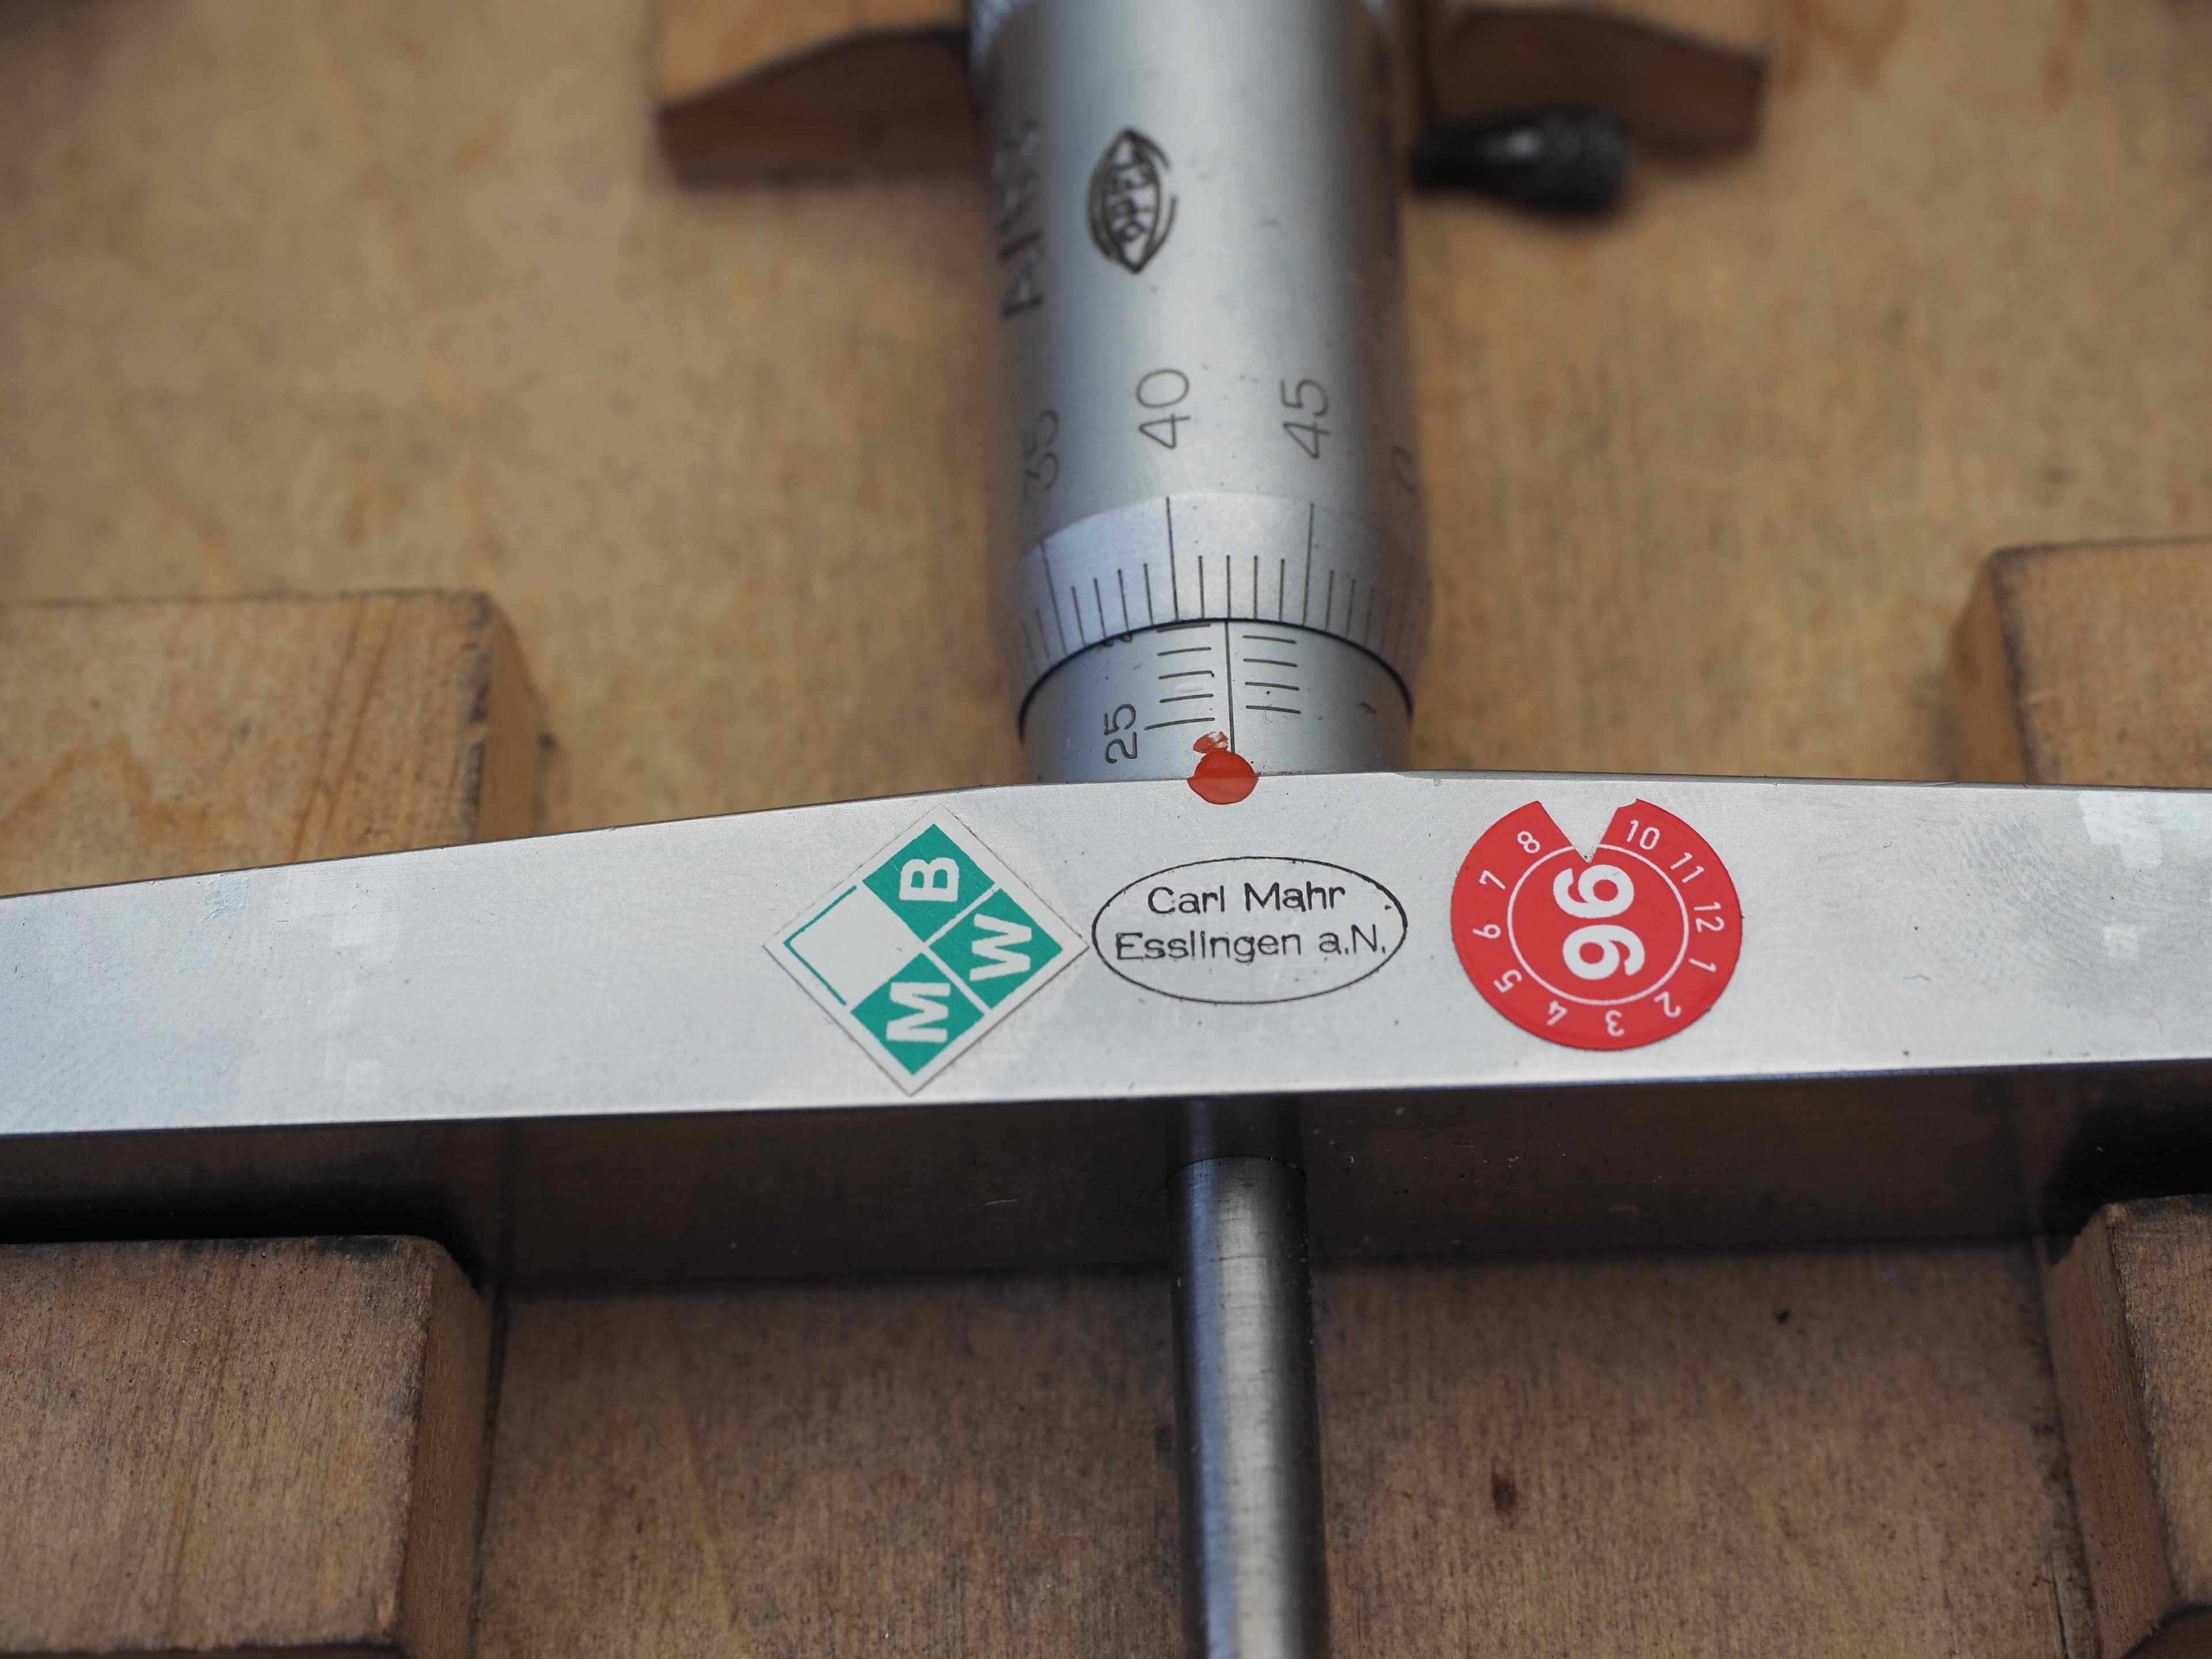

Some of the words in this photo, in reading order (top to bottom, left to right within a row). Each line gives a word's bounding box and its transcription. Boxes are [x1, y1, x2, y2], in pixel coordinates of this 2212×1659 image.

[1136, 369, 1191, 449] 40
[1280, 378, 1331, 459] 45
[1103, 703, 1138, 764] 25
[1517, 831, 1540, 854] 8
[1626, 820, 1661, 850] 10
[1478, 870, 1506, 890] 7
[1670, 852, 1705, 883] 11
[1147, 885, 1225, 915] Carl
[1244, 881, 1346, 912] Mahr
[1472, 923, 1501, 940] 6
[1552, 863, 1646, 980] 96
[1693, 902, 1725, 933] 12
[1115, 930, 1301, 964] Esslingen
[1319, 923, 1387, 955] a.N.
[1688, 958, 1717, 973] 1
[1493, 969, 1522, 994] 5
[1547, 1000, 1568, 1026] 4
[1654, 991, 1681, 1018] 2
[1605, 1009, 1626, 1037] 3
